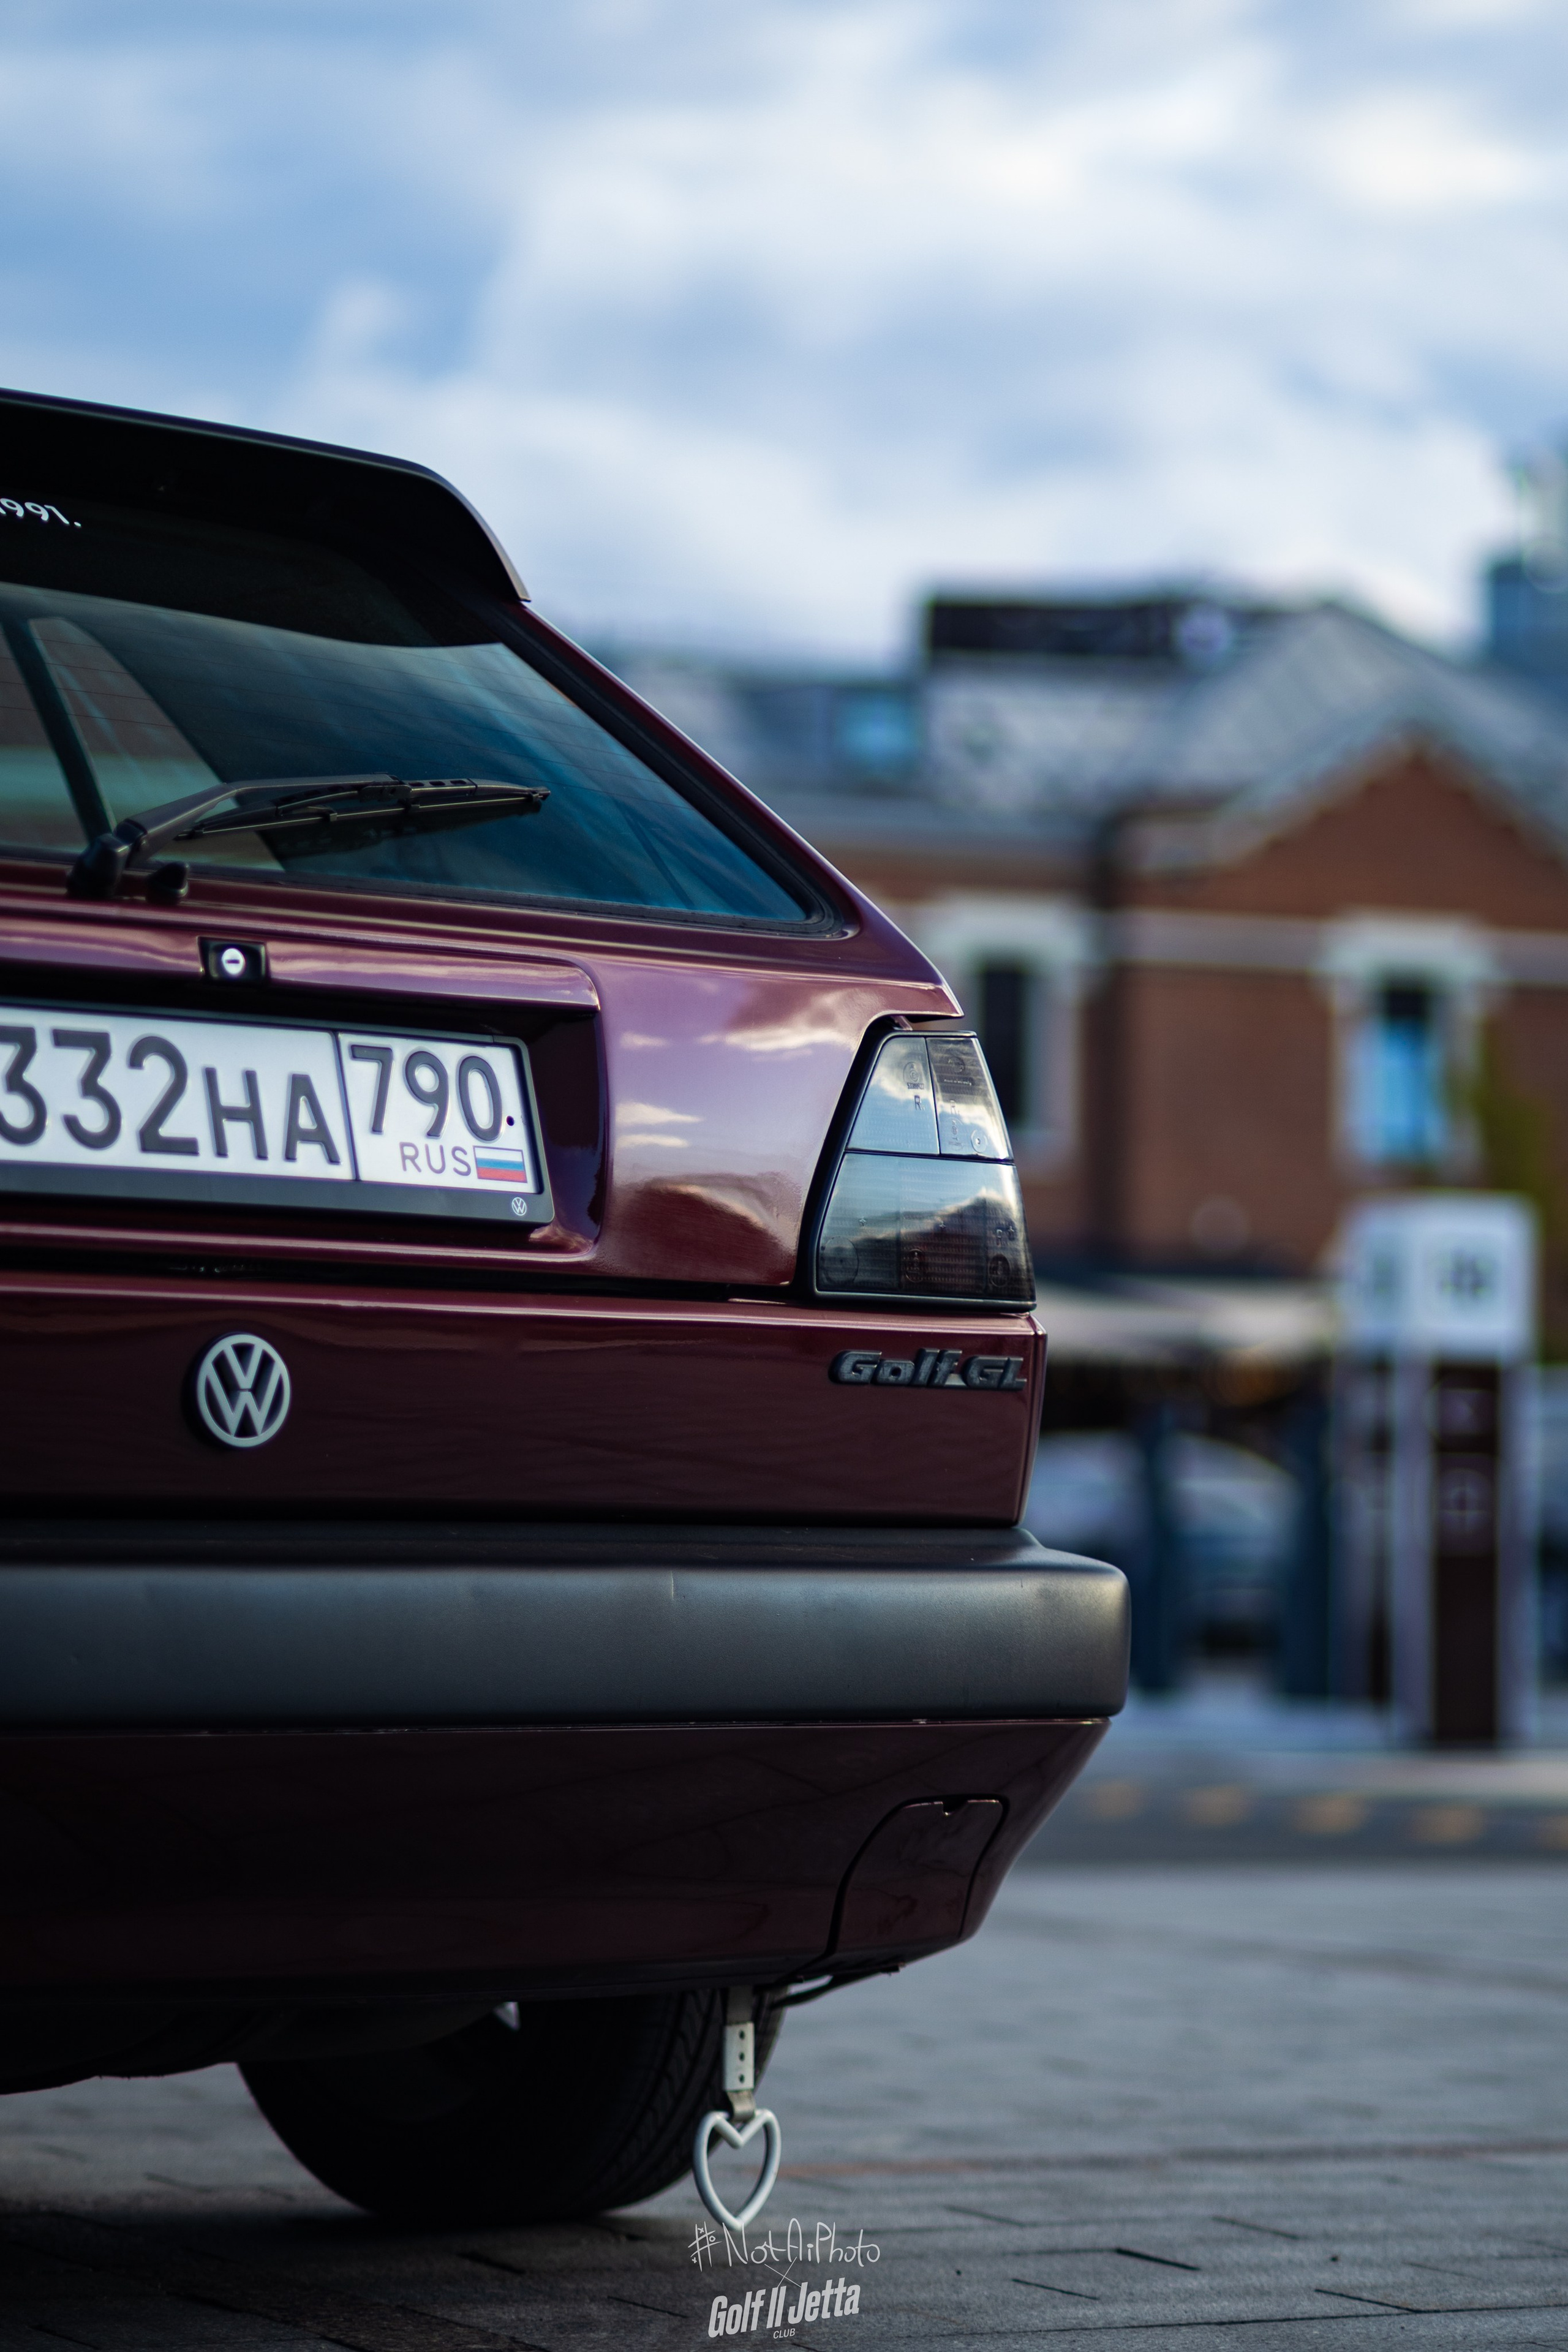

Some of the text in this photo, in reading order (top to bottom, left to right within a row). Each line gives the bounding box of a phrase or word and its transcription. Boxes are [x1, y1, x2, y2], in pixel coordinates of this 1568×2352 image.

[0, 497, 81, 527] 991.
[350, 1044, 503, 1141] 790
[399, 1142, 472, 1176] RUS
[829, 1348, 1028, 1391] Golf GL
